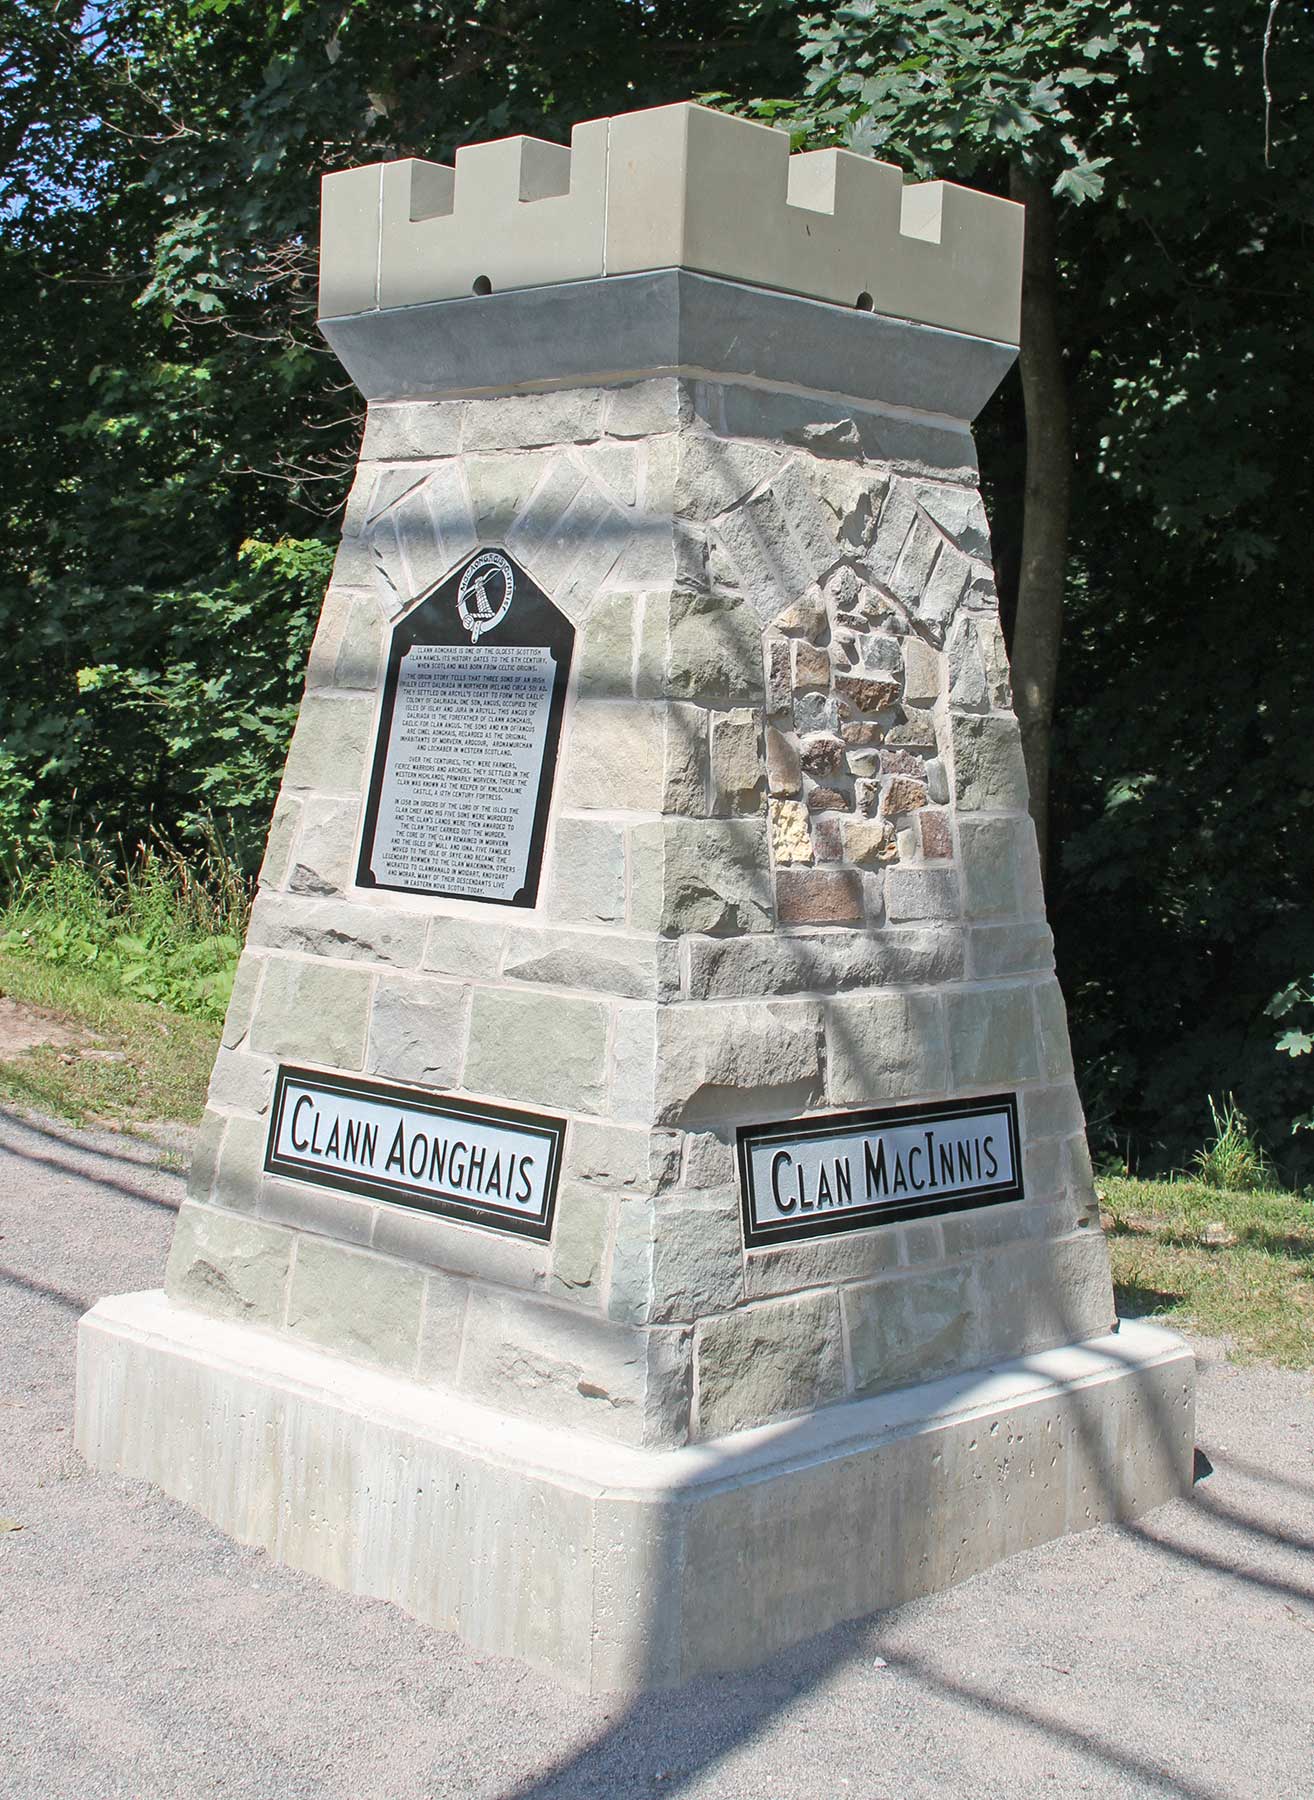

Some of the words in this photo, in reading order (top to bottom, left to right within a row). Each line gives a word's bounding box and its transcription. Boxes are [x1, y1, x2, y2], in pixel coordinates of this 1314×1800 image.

[492, 741, 533, 749] ARDNAMURCHAN
[412, 764, 435, 772] WARRIORS
[488, 769, 512, 777] SETTLED
[452, 791, 475, 799] CENTURY
[492, 806, 507, 814] ISLES
[416, 816, 434, 824] CLAN'S
[452, 819, 466, 827] WERE
[482, 822, 506, 830] AWARDED
[486, 814, 513, 822] MURDERED
[439, 826, 460, 834] CARRIED
[438, 834, 452, 842] CLAN
[453, 836, 478, 844] REMAINED
[485, 839, 509, 847] MORVERN
[392, 846, 409, 854] MOVED
[474, 854, 495, 862] BECAME
[435, 842, 448, 850] MULL
[488, 848, 511, 856] FAMILIES
[382, 853, 409, 861] LEGENDARY
[410, 856, 431, 864] BOWMEN
[495, 865, 516, 873] OTHERS
[386, 861, 410, 870] MIGRATED
[410, 880, 433, 888] EASTERN
[447, 884, 465, 892] SCOTIA
[441, 875, 455, 883] THEIR
[456, 877, 492, 887] DESCENDANTS
[291, 1094, 379, 1168] CLANN
[385, 1117, 535, 1203] AONGHAIS
[771, 1150, 852, 1215] CLAN
